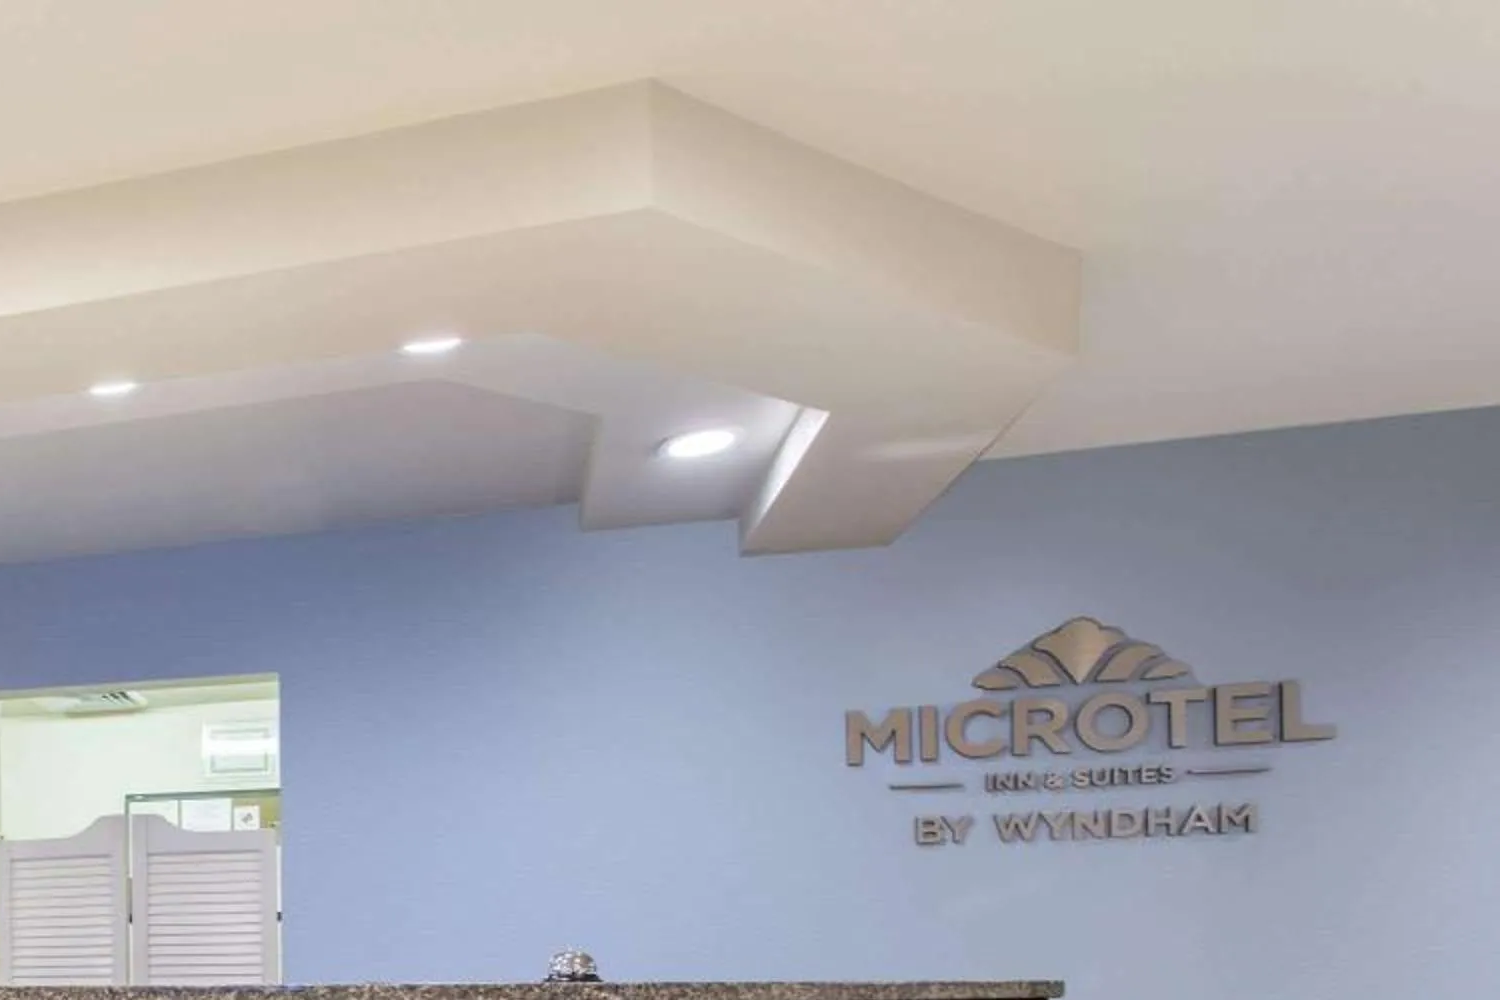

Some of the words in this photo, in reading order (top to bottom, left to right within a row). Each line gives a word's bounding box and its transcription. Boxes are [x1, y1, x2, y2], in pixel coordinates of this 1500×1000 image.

[845, 678, 1337, 767] MICROTEL
[984, 772, 1036, 793] INN
[1043, 770, 1065, 790] &
[1072, 764, 1176, 788] SUITES
[914, 815, 975, 846] BY
[993, 802, 1258, 843] WYNDHAM
